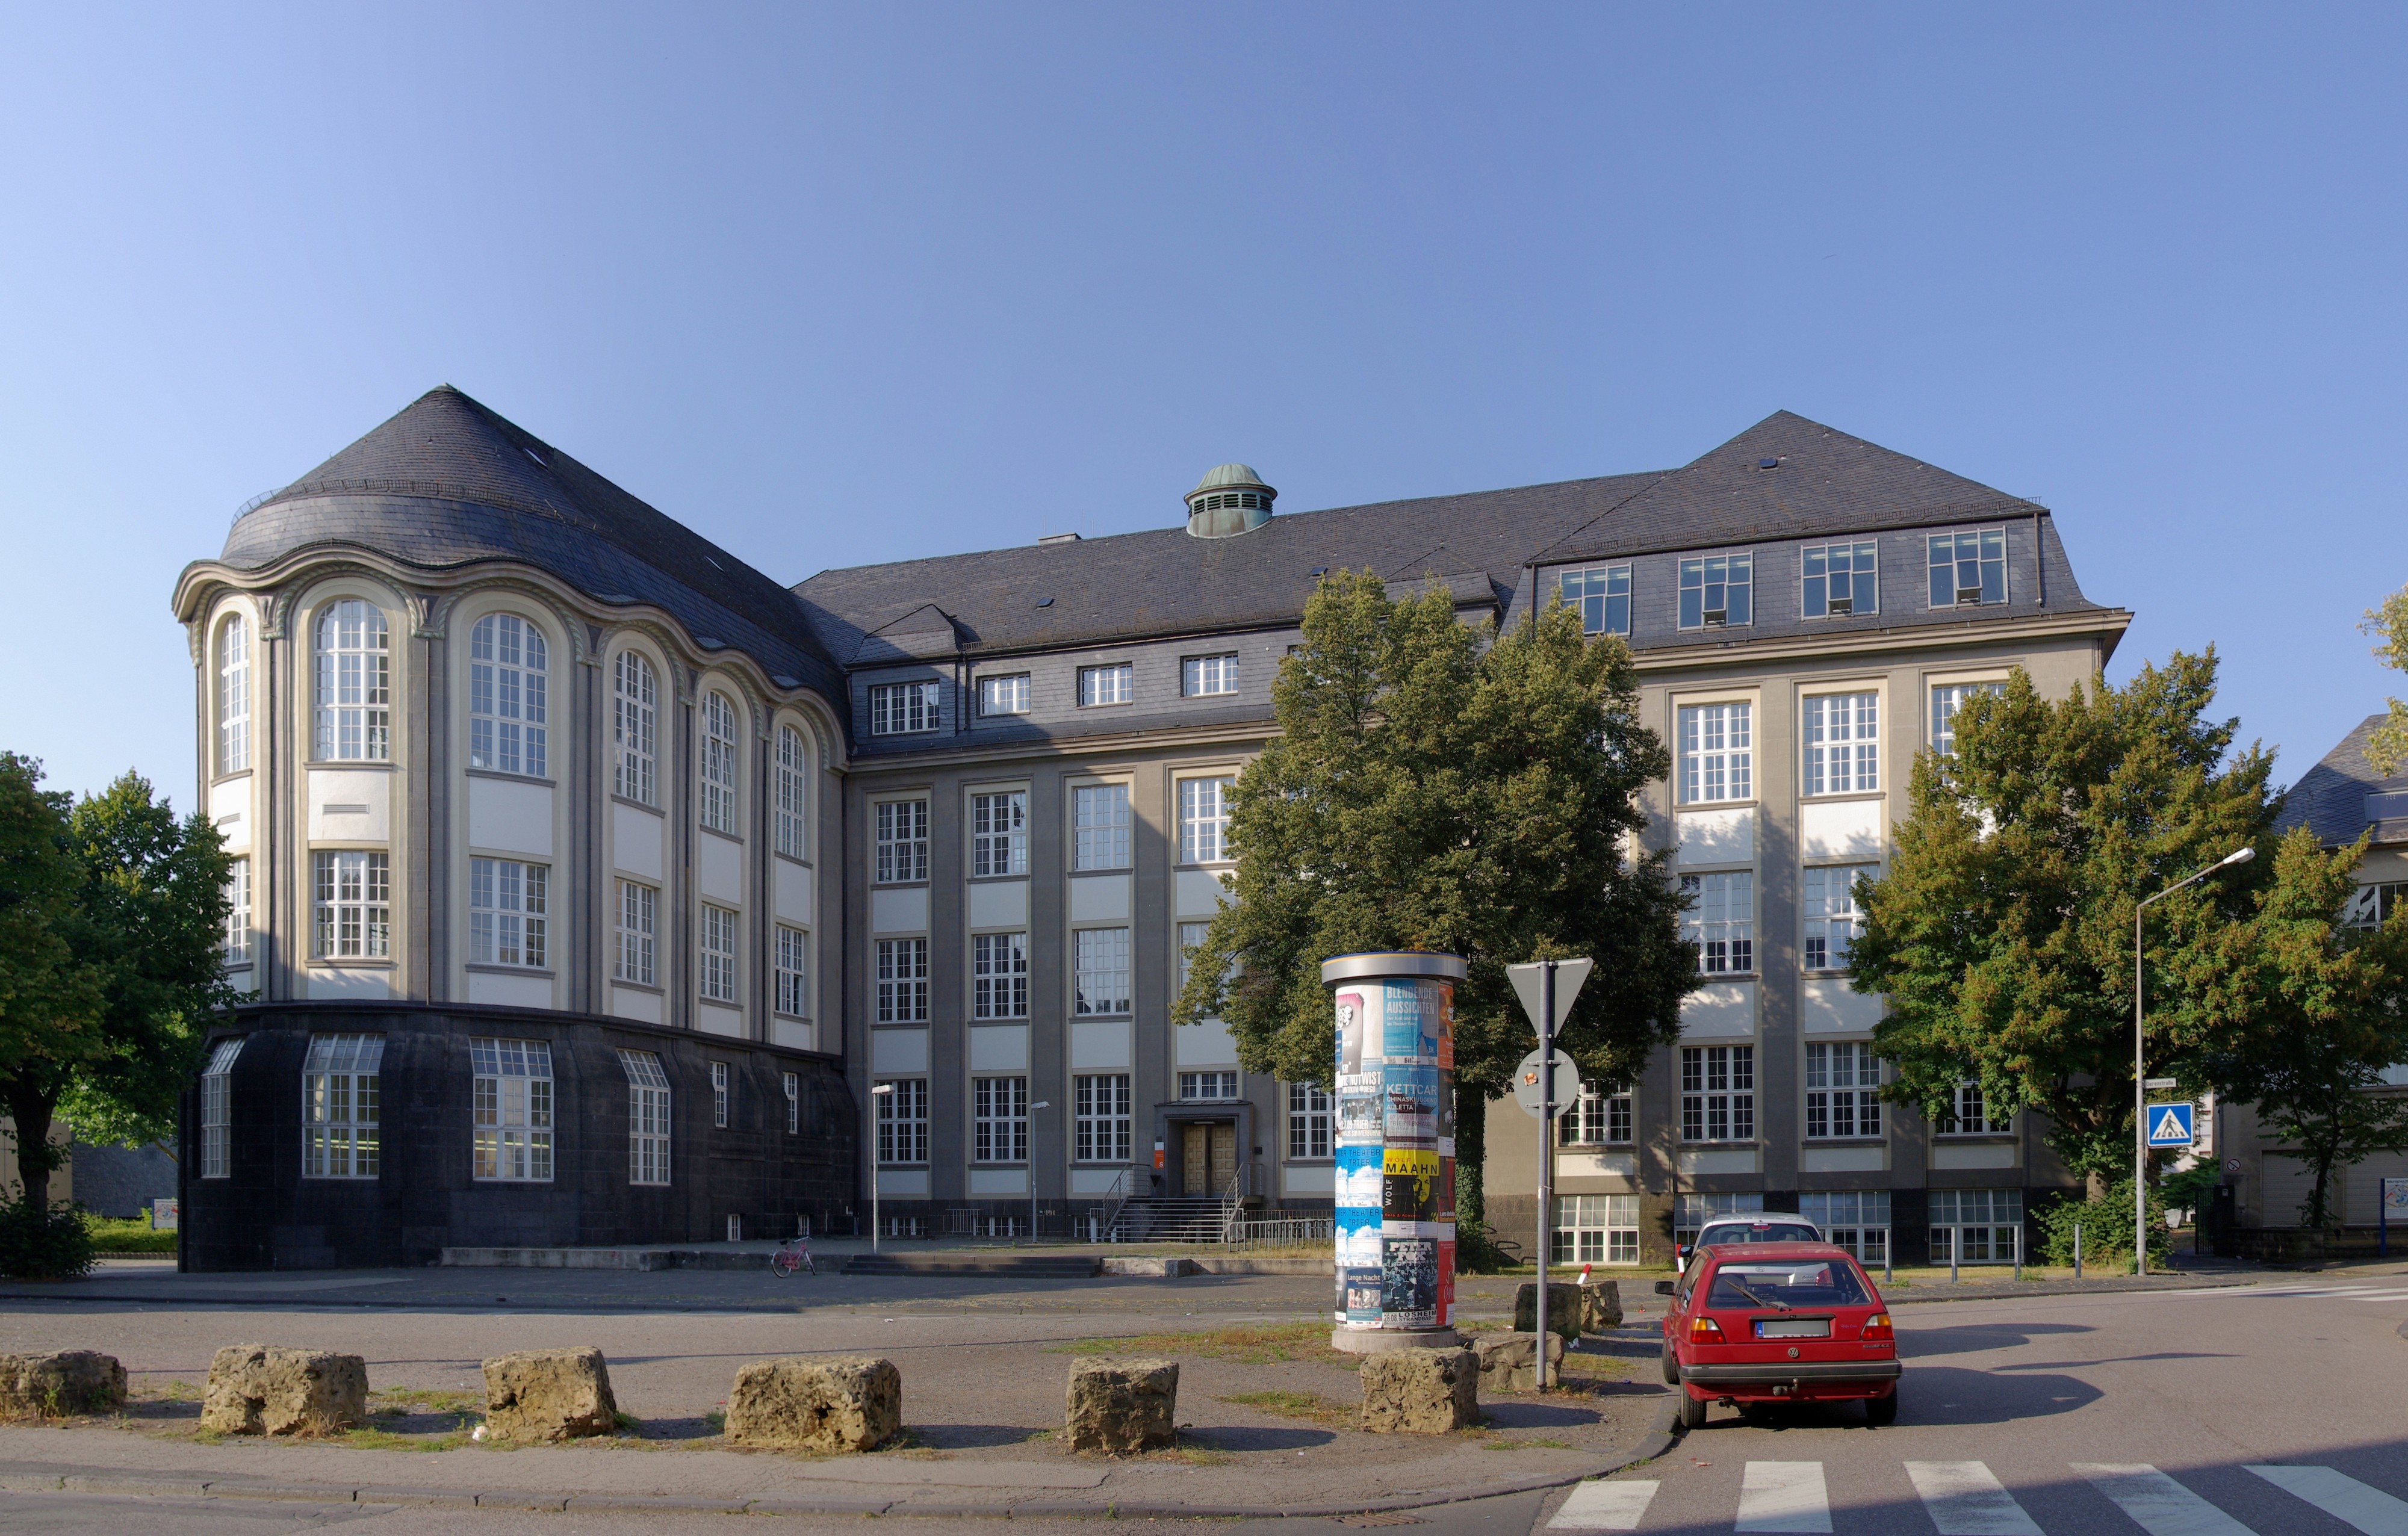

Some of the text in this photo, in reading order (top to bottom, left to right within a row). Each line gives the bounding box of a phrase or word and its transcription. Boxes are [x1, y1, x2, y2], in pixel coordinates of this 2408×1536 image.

[1387, 986, 1433, 999] BLENDENDE
[1386, 1001, 1435, 1015] AUSSICHTEN
[1386, 1084, 1437, 1095] KETTCAR
[1353, 1120, 1368, 1130] TRIER
[1386, 1163, 1438, 1174] MAAHN
[1389, 1242, 1432, 1252] PETER
[1397, 1251, 1427, 1262] FOX
[1348, 1274, 1362, 1283] Lange
